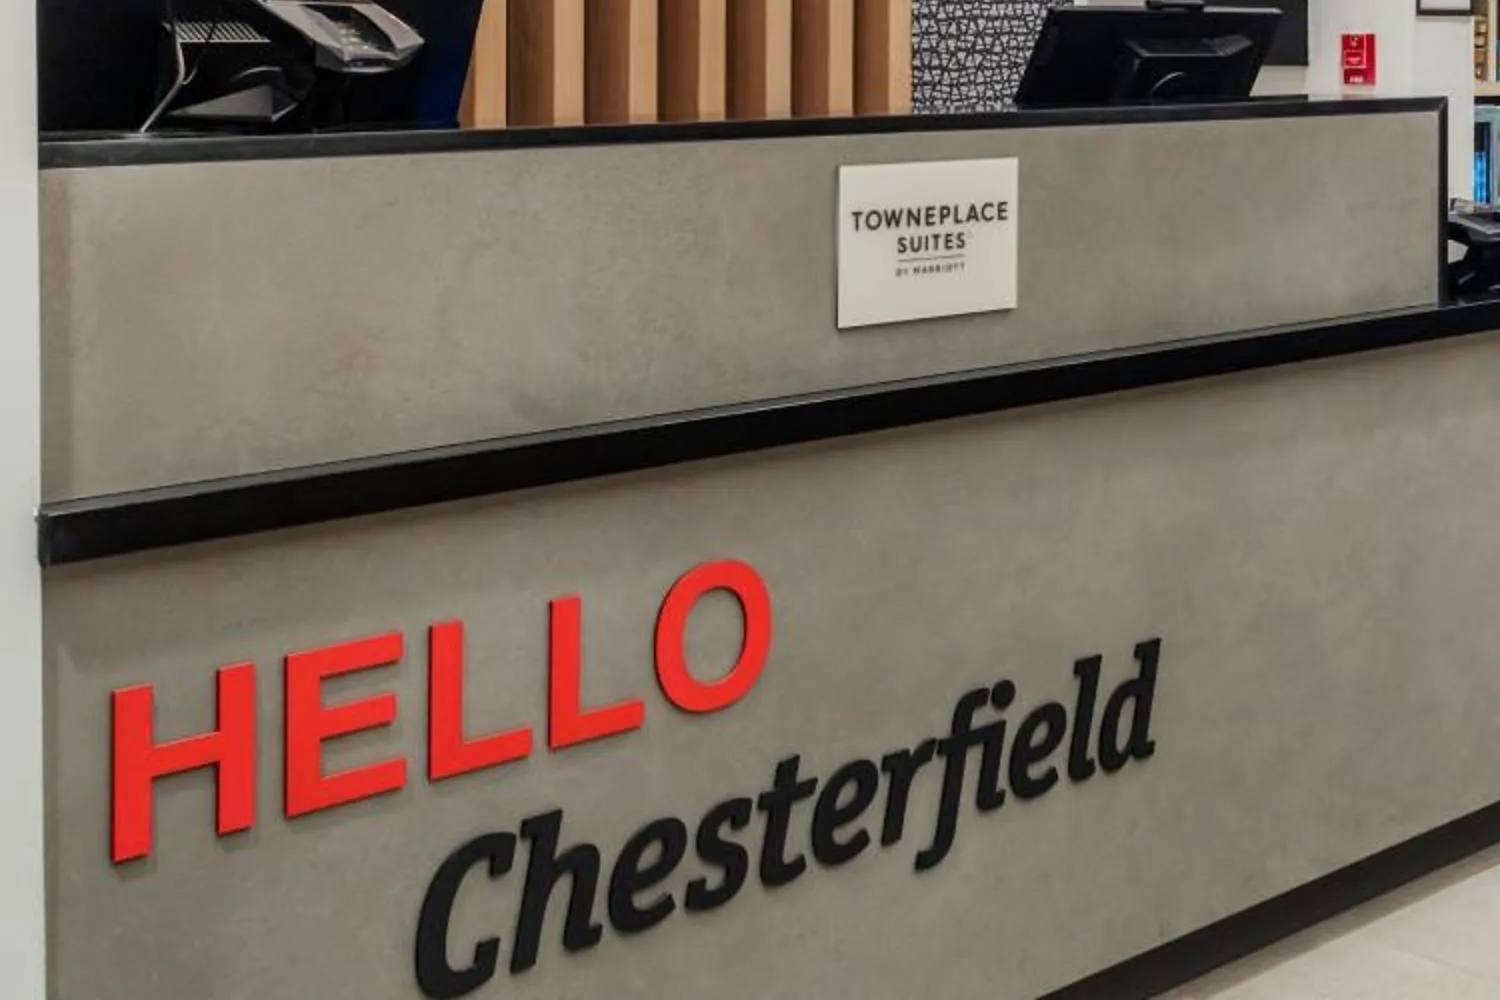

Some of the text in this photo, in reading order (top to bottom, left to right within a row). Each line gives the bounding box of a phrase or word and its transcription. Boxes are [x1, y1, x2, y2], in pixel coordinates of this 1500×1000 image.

[852, 201, 1009, 232] TOWNEPLACE
[897, 231, 966, 254] SUITES
[896, 261, 966, 278] BY MARRIOTT
[109, 557, 773, 864] HELLO
[414, 637, 1163, 1000] Chesterfield
